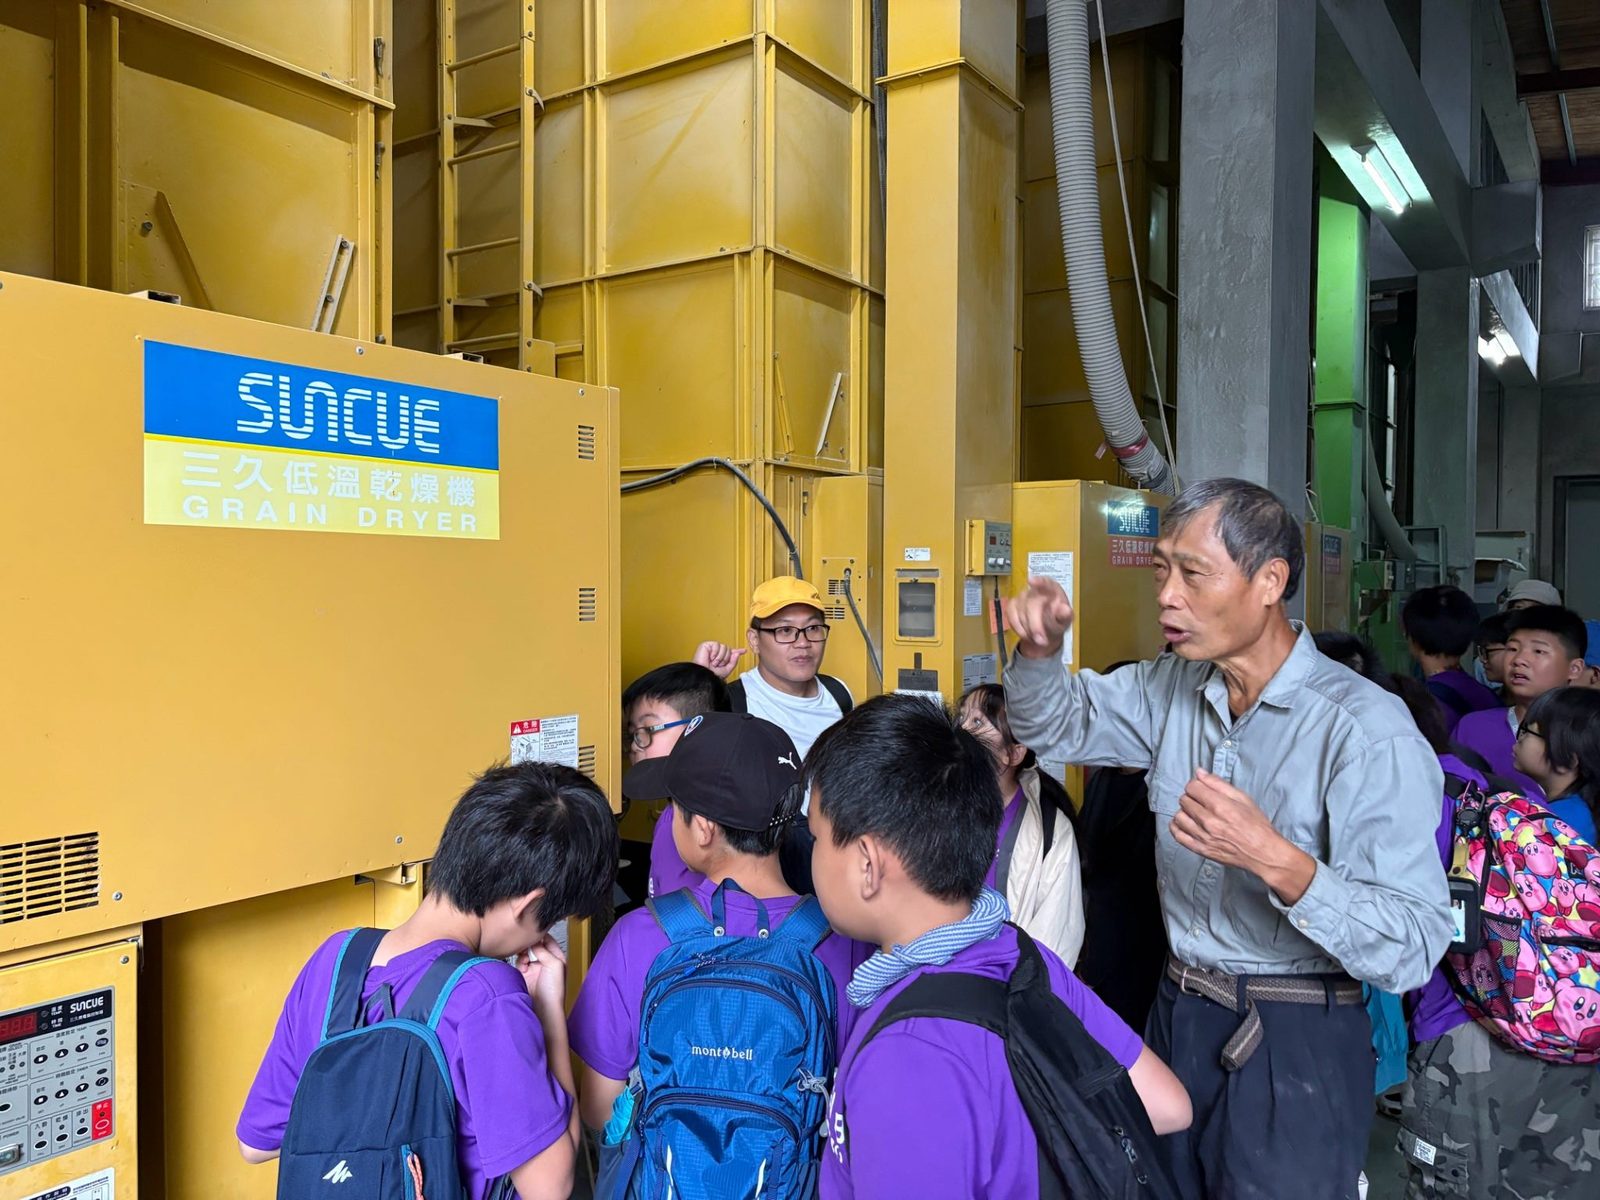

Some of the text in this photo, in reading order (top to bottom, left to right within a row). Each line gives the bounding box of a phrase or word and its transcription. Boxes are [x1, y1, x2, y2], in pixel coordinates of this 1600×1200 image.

[236, 371, 440, 454] SUNCUE
[181, 450, 476, 508] 三久低溫乾燥機
[182, 495, 477, 533] GRAIN DRYER
[69, 996, 104, 1014] SUNCUE
